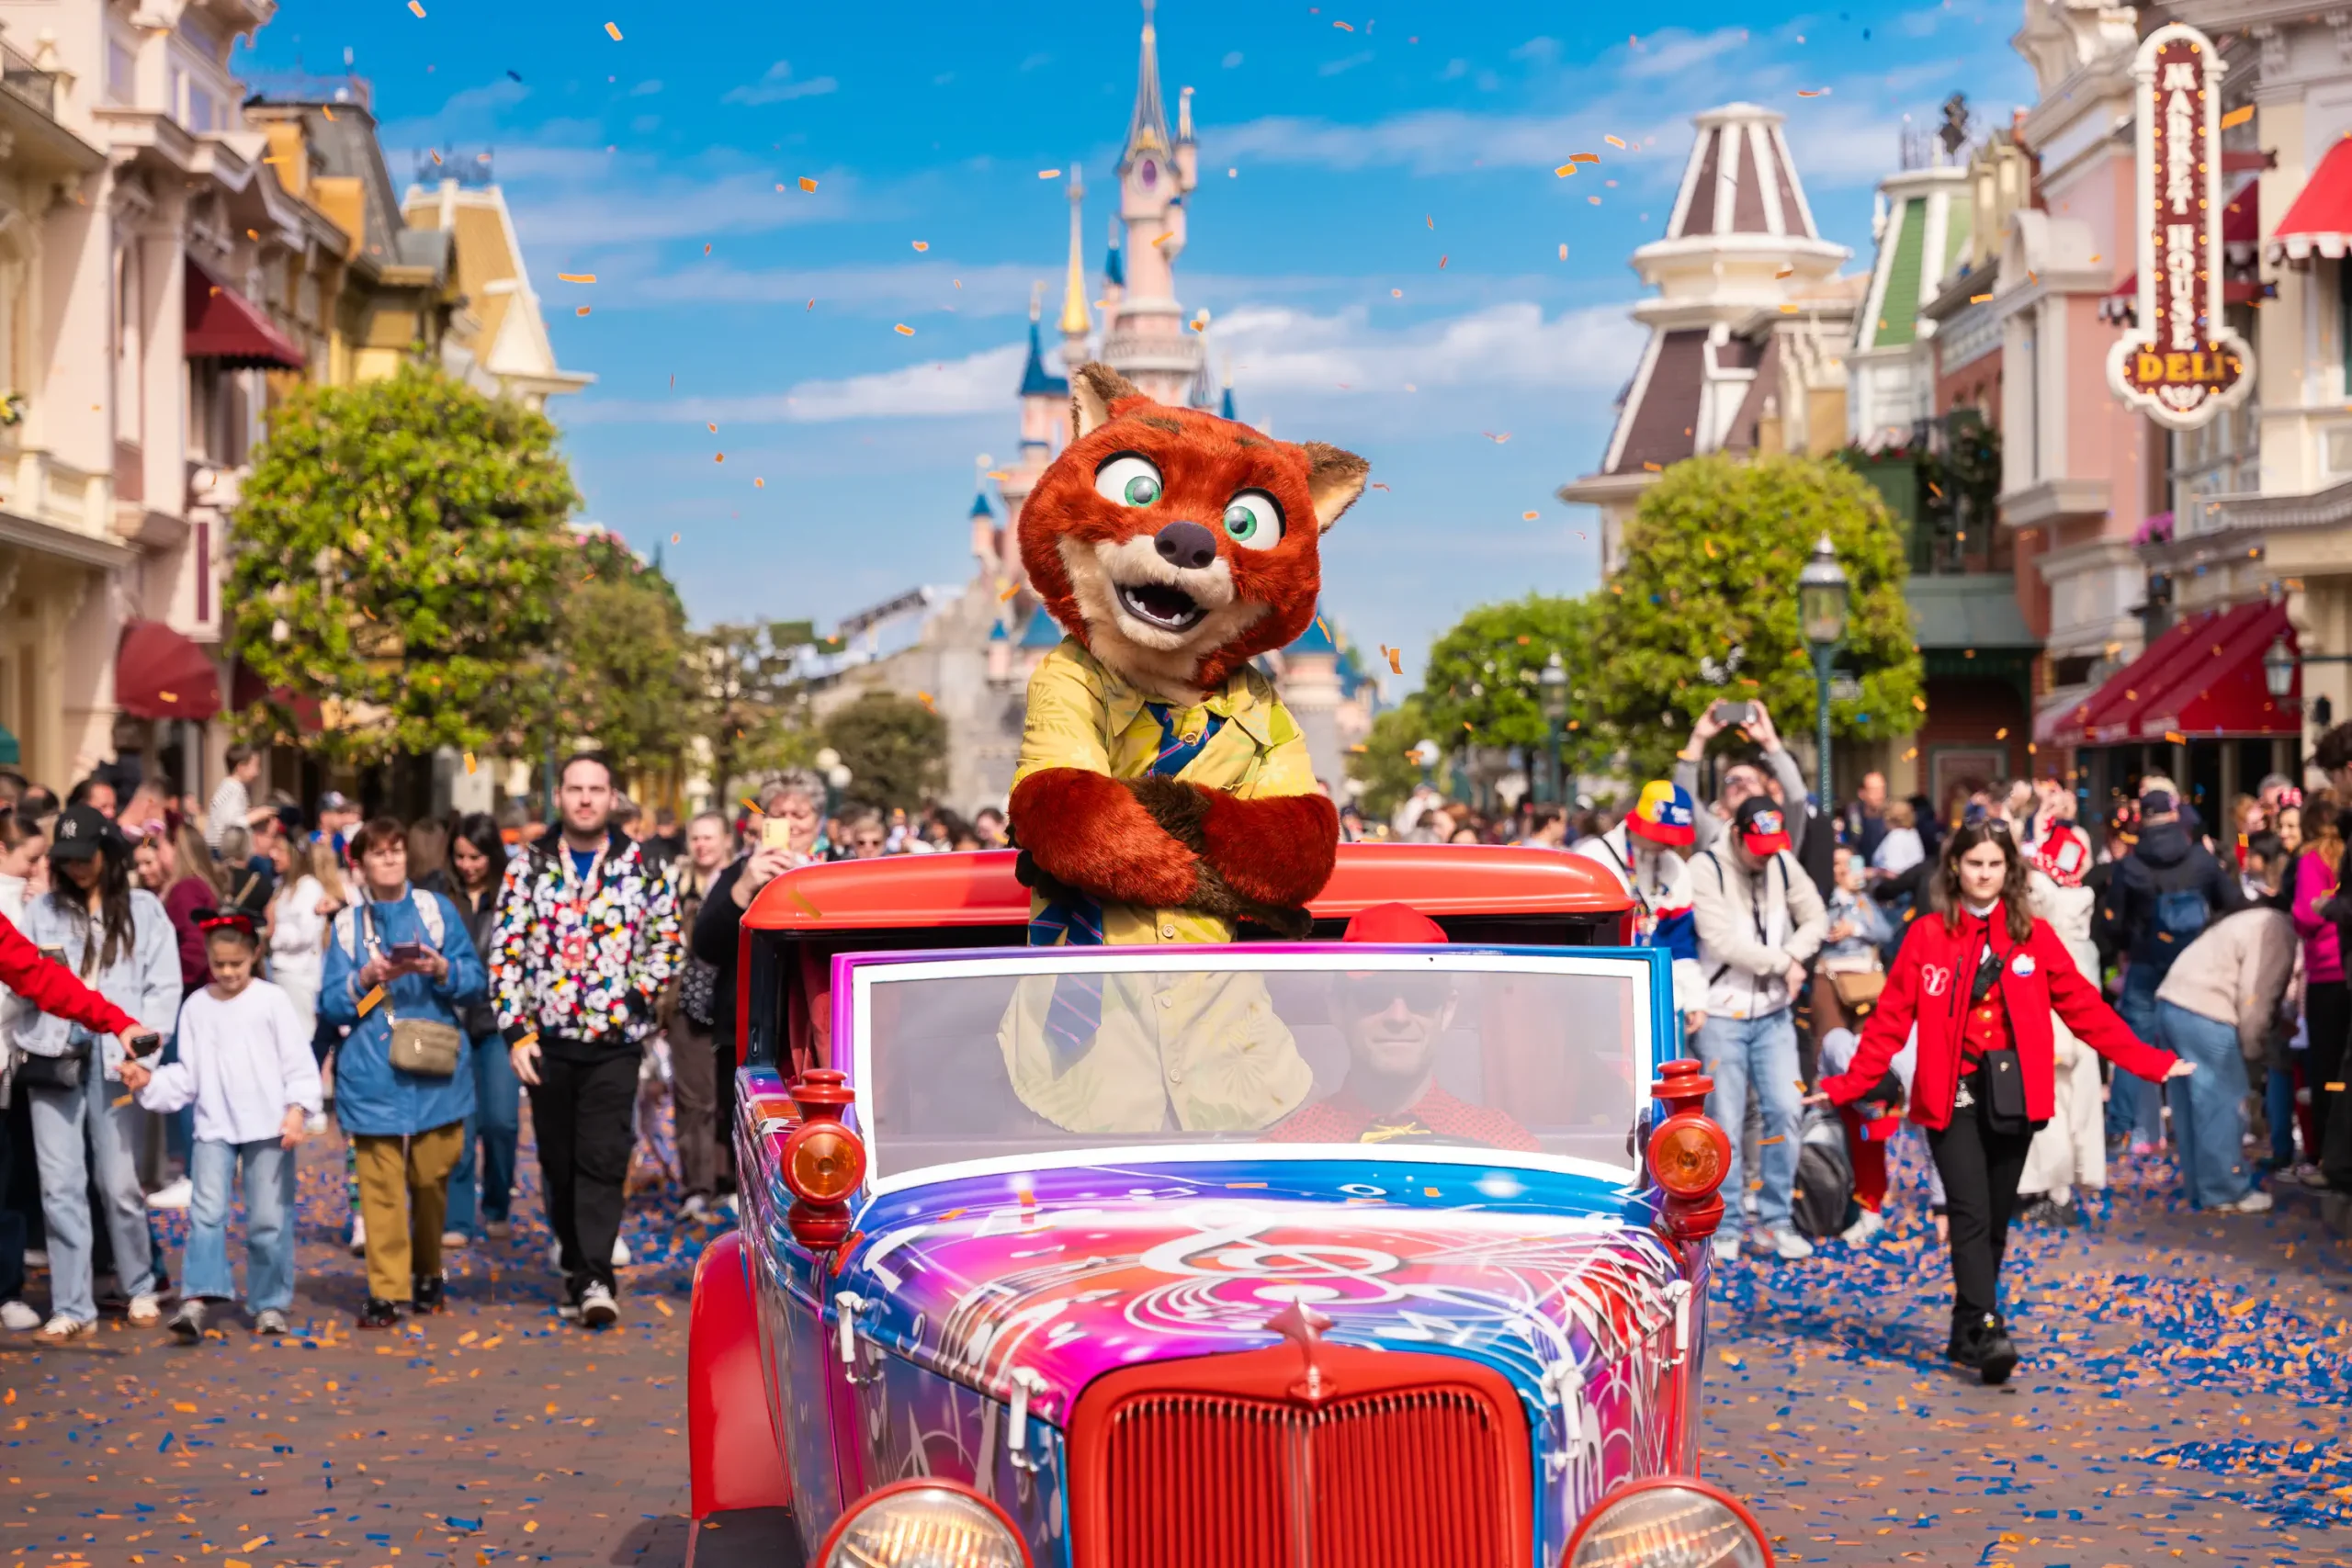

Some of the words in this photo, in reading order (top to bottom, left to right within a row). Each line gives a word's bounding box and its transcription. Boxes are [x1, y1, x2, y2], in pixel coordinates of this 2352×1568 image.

[2163, 62, 2198, 215] MARKET
[2165, 224, 2195, 350] HOUSE
[2137, 352, 2225, 382] DELI
